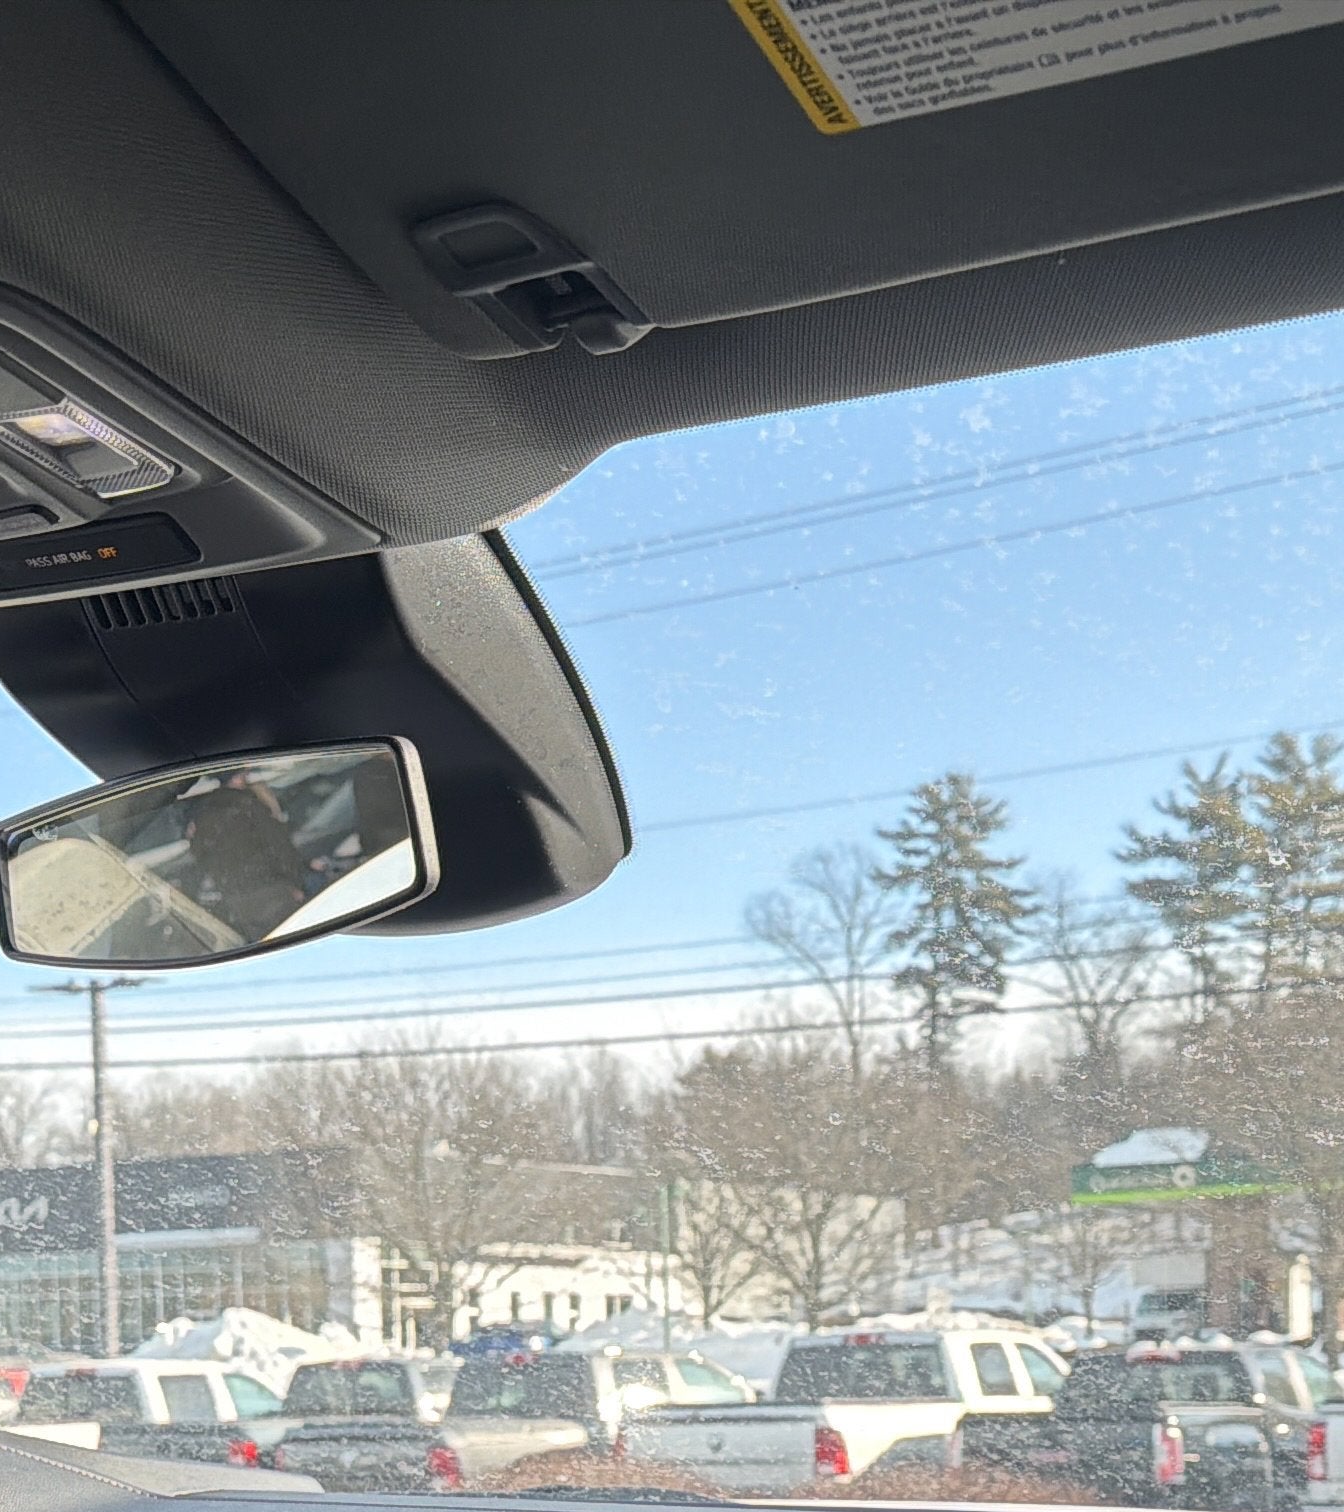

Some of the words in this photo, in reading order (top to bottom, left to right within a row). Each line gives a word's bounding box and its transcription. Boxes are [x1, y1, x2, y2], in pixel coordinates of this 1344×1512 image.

[26, 556, 52, 568] PASS
[52, 553, 70, 566] AIR
[71, 550, 92, 562] BAG
[97, 547, 119, 560] OFF
